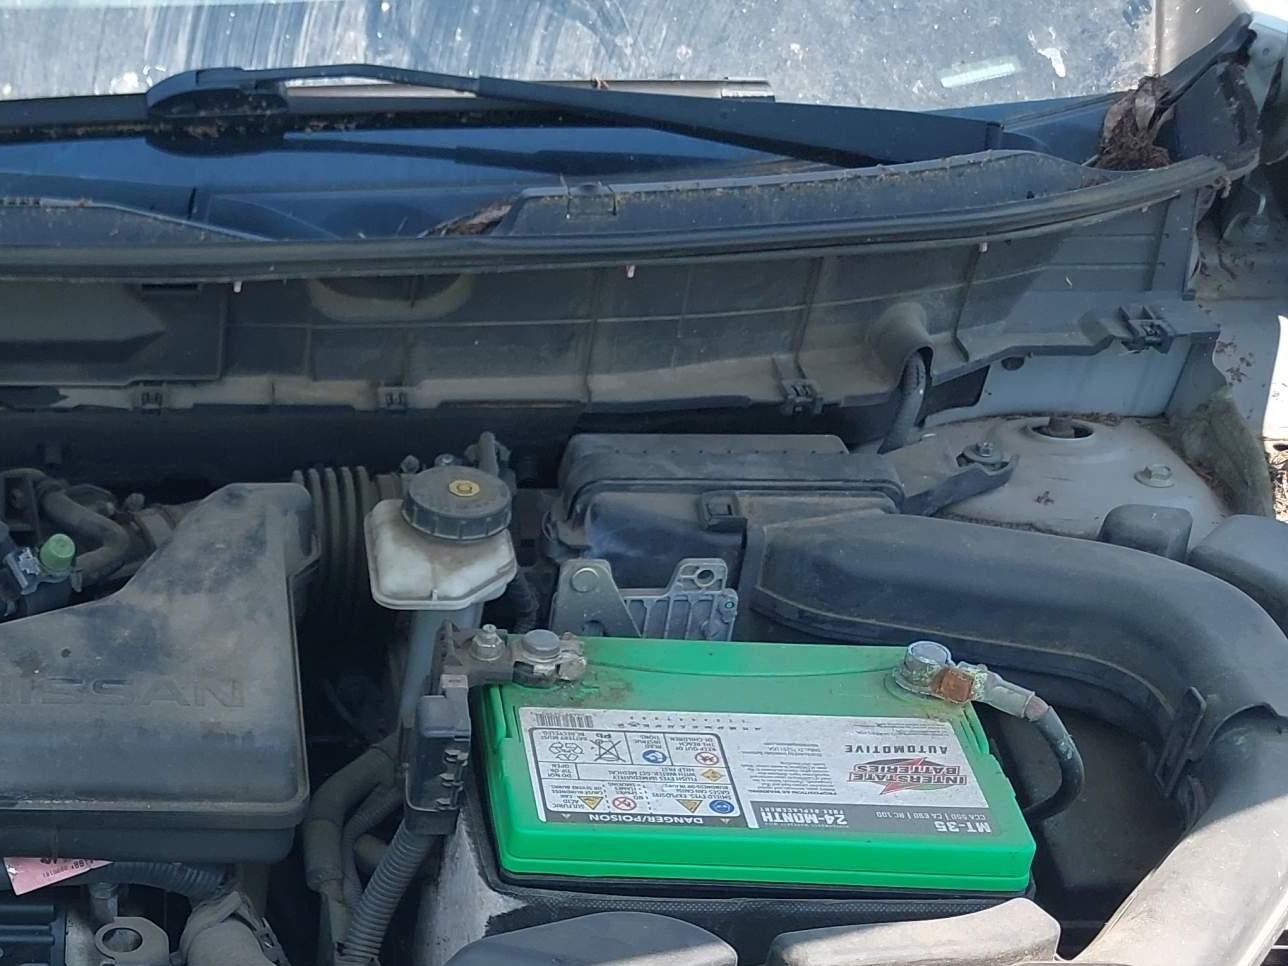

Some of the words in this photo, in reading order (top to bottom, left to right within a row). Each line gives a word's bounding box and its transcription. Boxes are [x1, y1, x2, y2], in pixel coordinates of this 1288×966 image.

[844, 745, 948, 754] AUTOMOTIVE
[854, 765, 958, 774] BATTERIES
[850, 774, 966, 784] INTERSTATE
[589, 813, 703, 824] DANGER/POISON
[761, 812, 847, 824] 24-MONTH
[934, 821, 992, 832] MT-35
